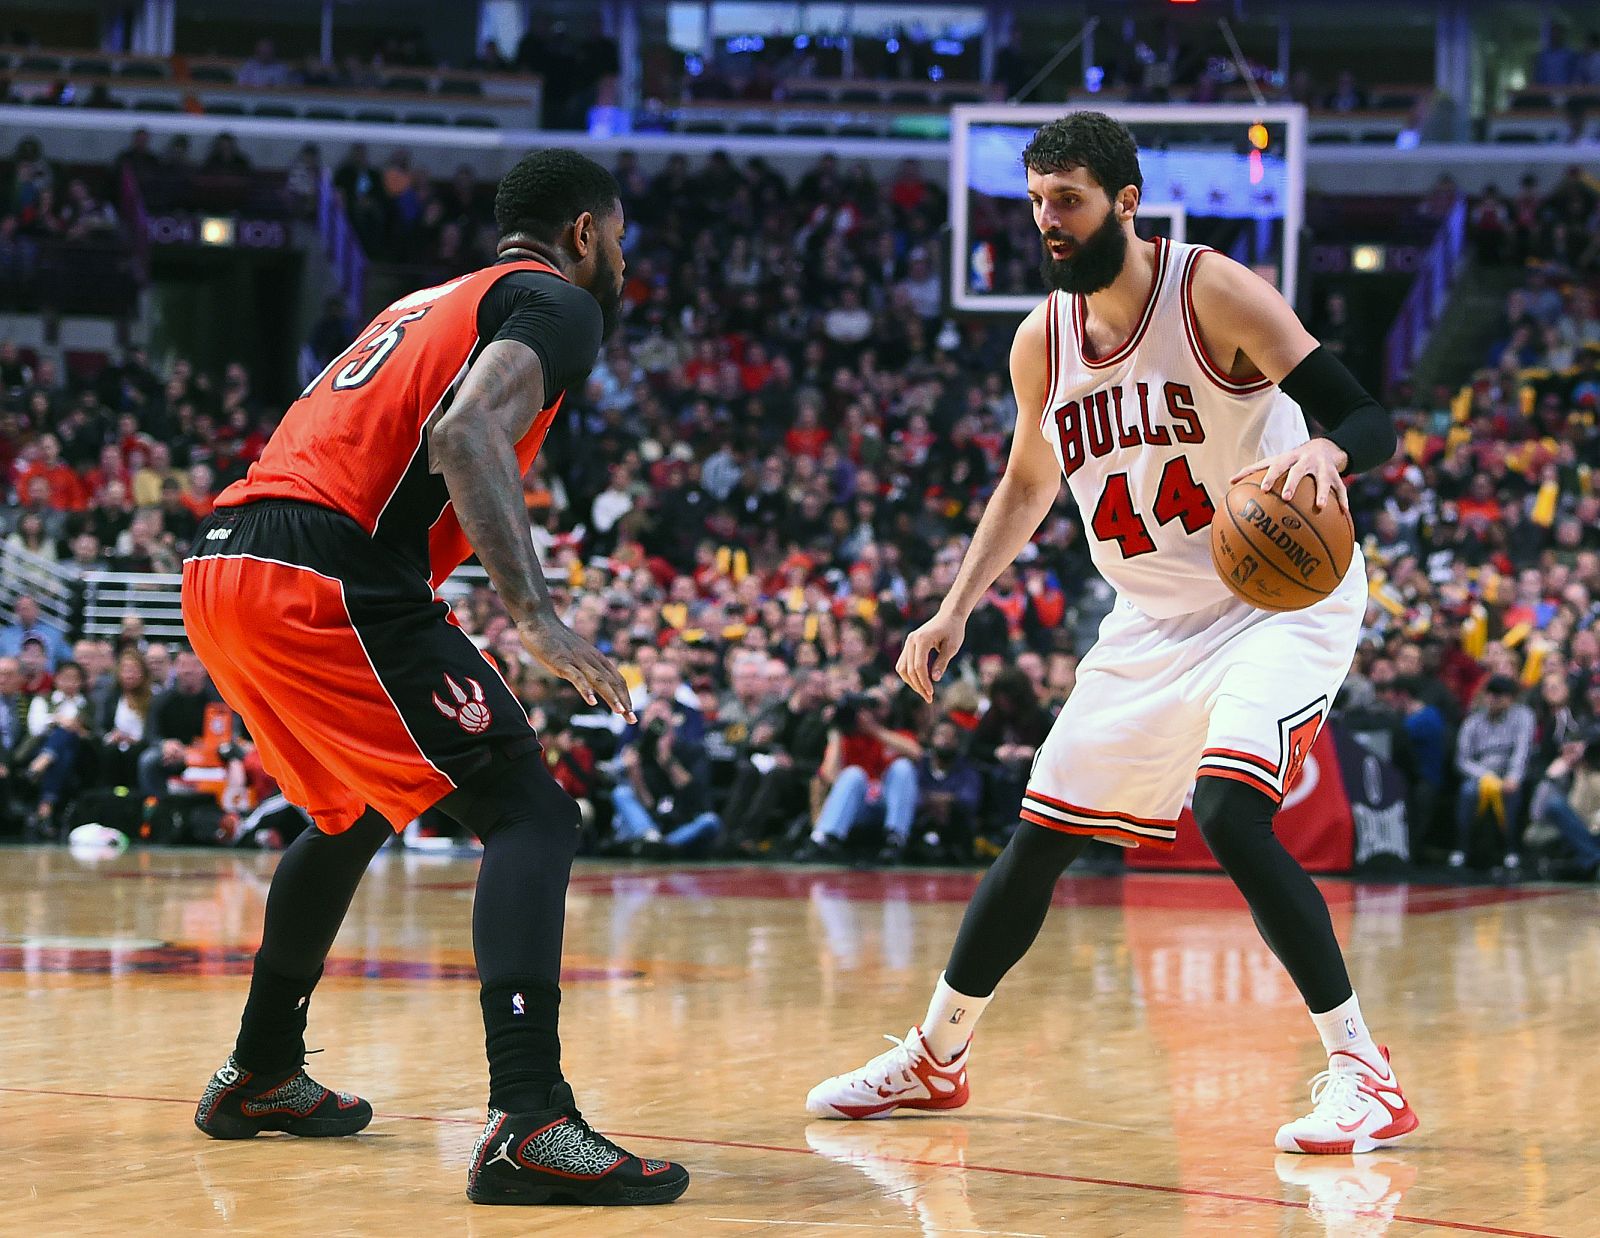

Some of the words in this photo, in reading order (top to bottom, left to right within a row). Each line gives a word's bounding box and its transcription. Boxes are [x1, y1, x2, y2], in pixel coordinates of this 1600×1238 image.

[1055, 381, 1206, 479] BULLS
[1091, 454, 1216, 560] 44
[1238, 497, 1322, 582] SPALDING
